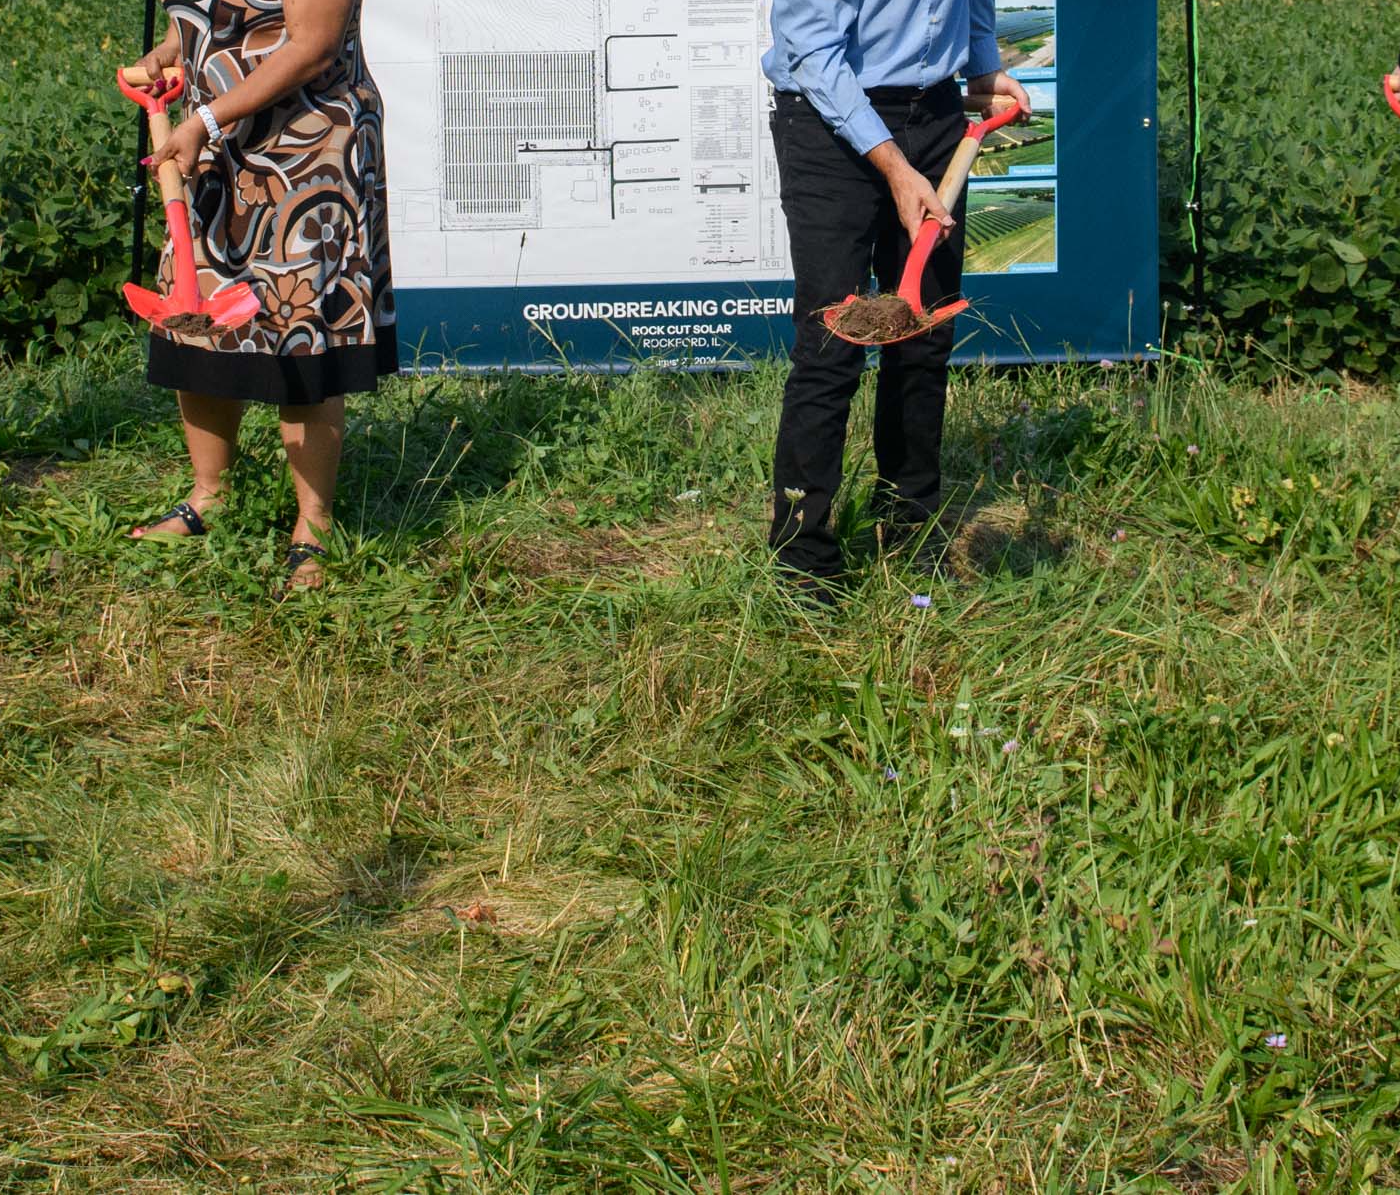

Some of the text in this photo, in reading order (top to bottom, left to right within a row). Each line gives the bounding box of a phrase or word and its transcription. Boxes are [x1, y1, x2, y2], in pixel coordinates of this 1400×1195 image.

[523, 298, 795, 320] GROUNDBREAKING CEREM
[632, 323, 732, 336] ROCK CUT SOLAR
[642, 337, 721, 349] ROCKFORD, IL
[694, 356, 717, 366] 2024
